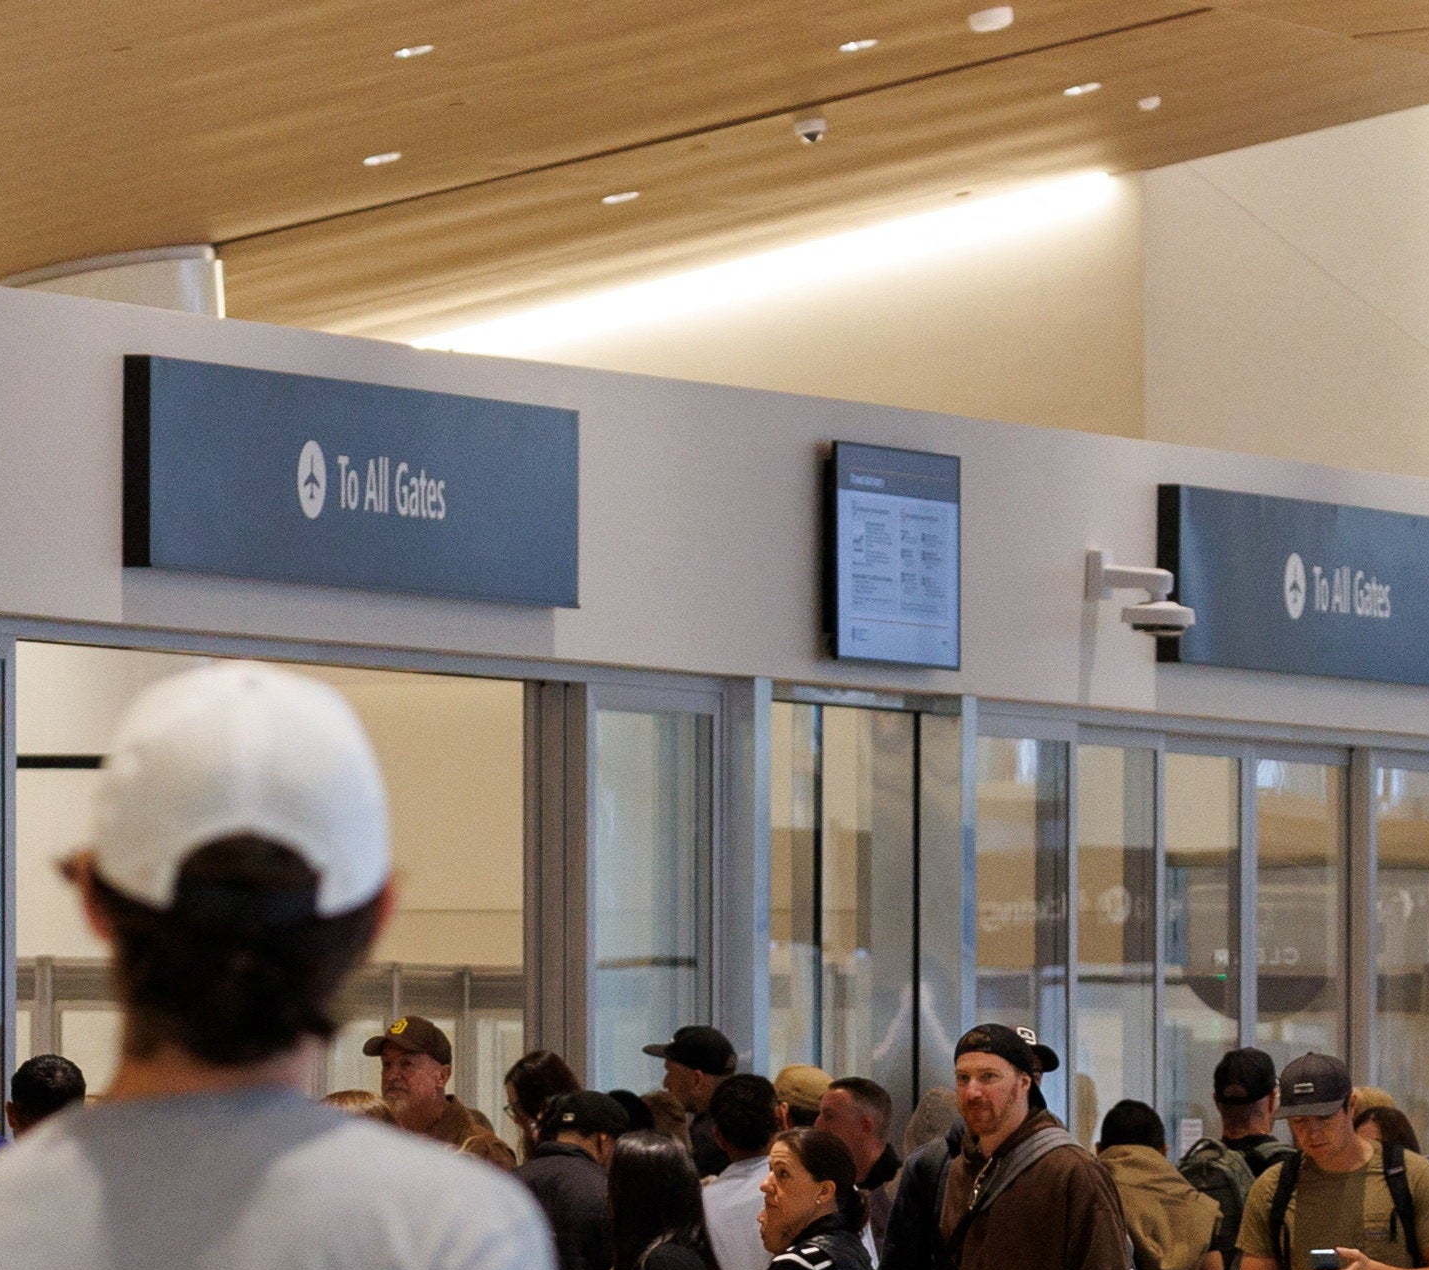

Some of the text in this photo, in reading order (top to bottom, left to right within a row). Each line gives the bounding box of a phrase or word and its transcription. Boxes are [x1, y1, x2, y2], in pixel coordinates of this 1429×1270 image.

[336, 455, 447, 520] To All Gates
[1312, 565, 1392, 618] To All Gates
